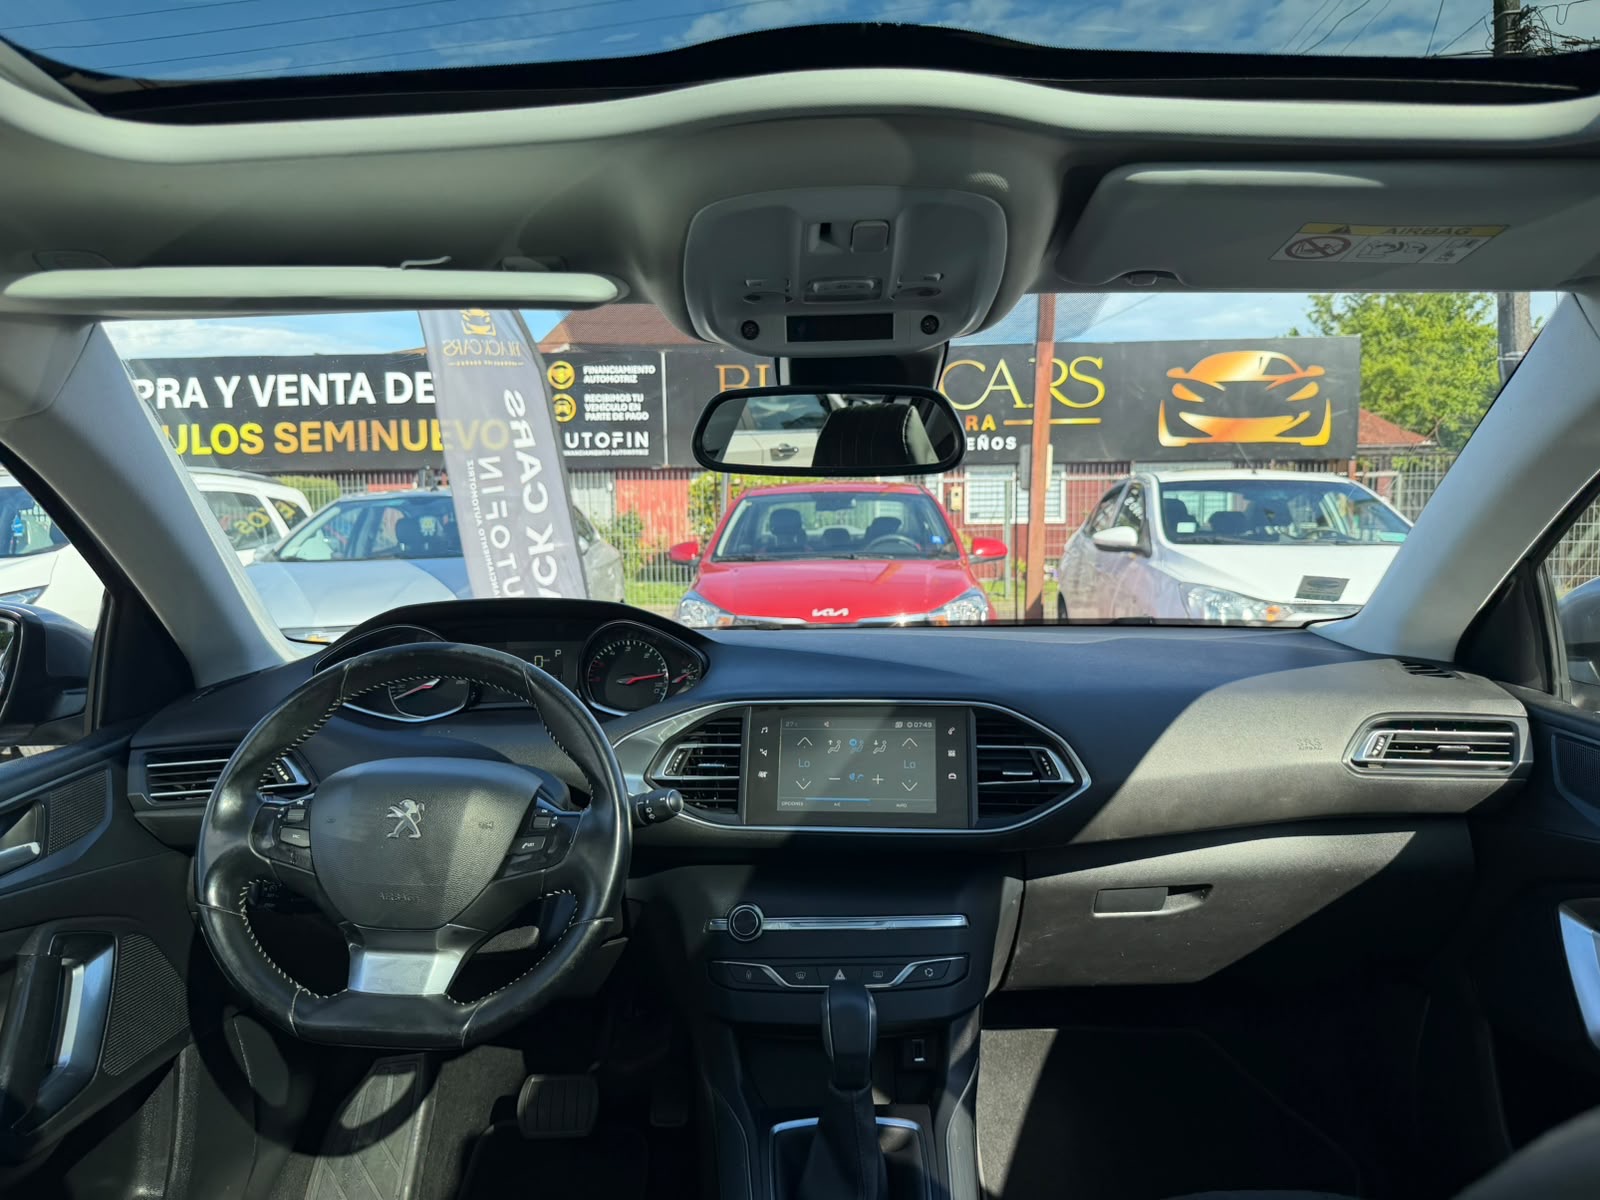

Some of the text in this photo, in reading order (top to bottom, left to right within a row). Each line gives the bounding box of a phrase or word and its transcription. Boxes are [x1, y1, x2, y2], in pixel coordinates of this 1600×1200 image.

[1382, 226, 1473, 236] AIRBAG
[582, 364, 656, 375] FINANCIAMIENTO
[583, 374, 638, 384] AUTOMOTRIZ
[213, 374, 241, 408] Y
[248, 372, 376, 407] VENTA
[384, 371, 437, 405] DE
[584, 393, 645, 403] RECIBIMOS TU
[628, 402, 641, 412] EN
[584, 411, 650, 421] PARTE DE PAGO
[564, 431, 649, 448] UTOFIN
